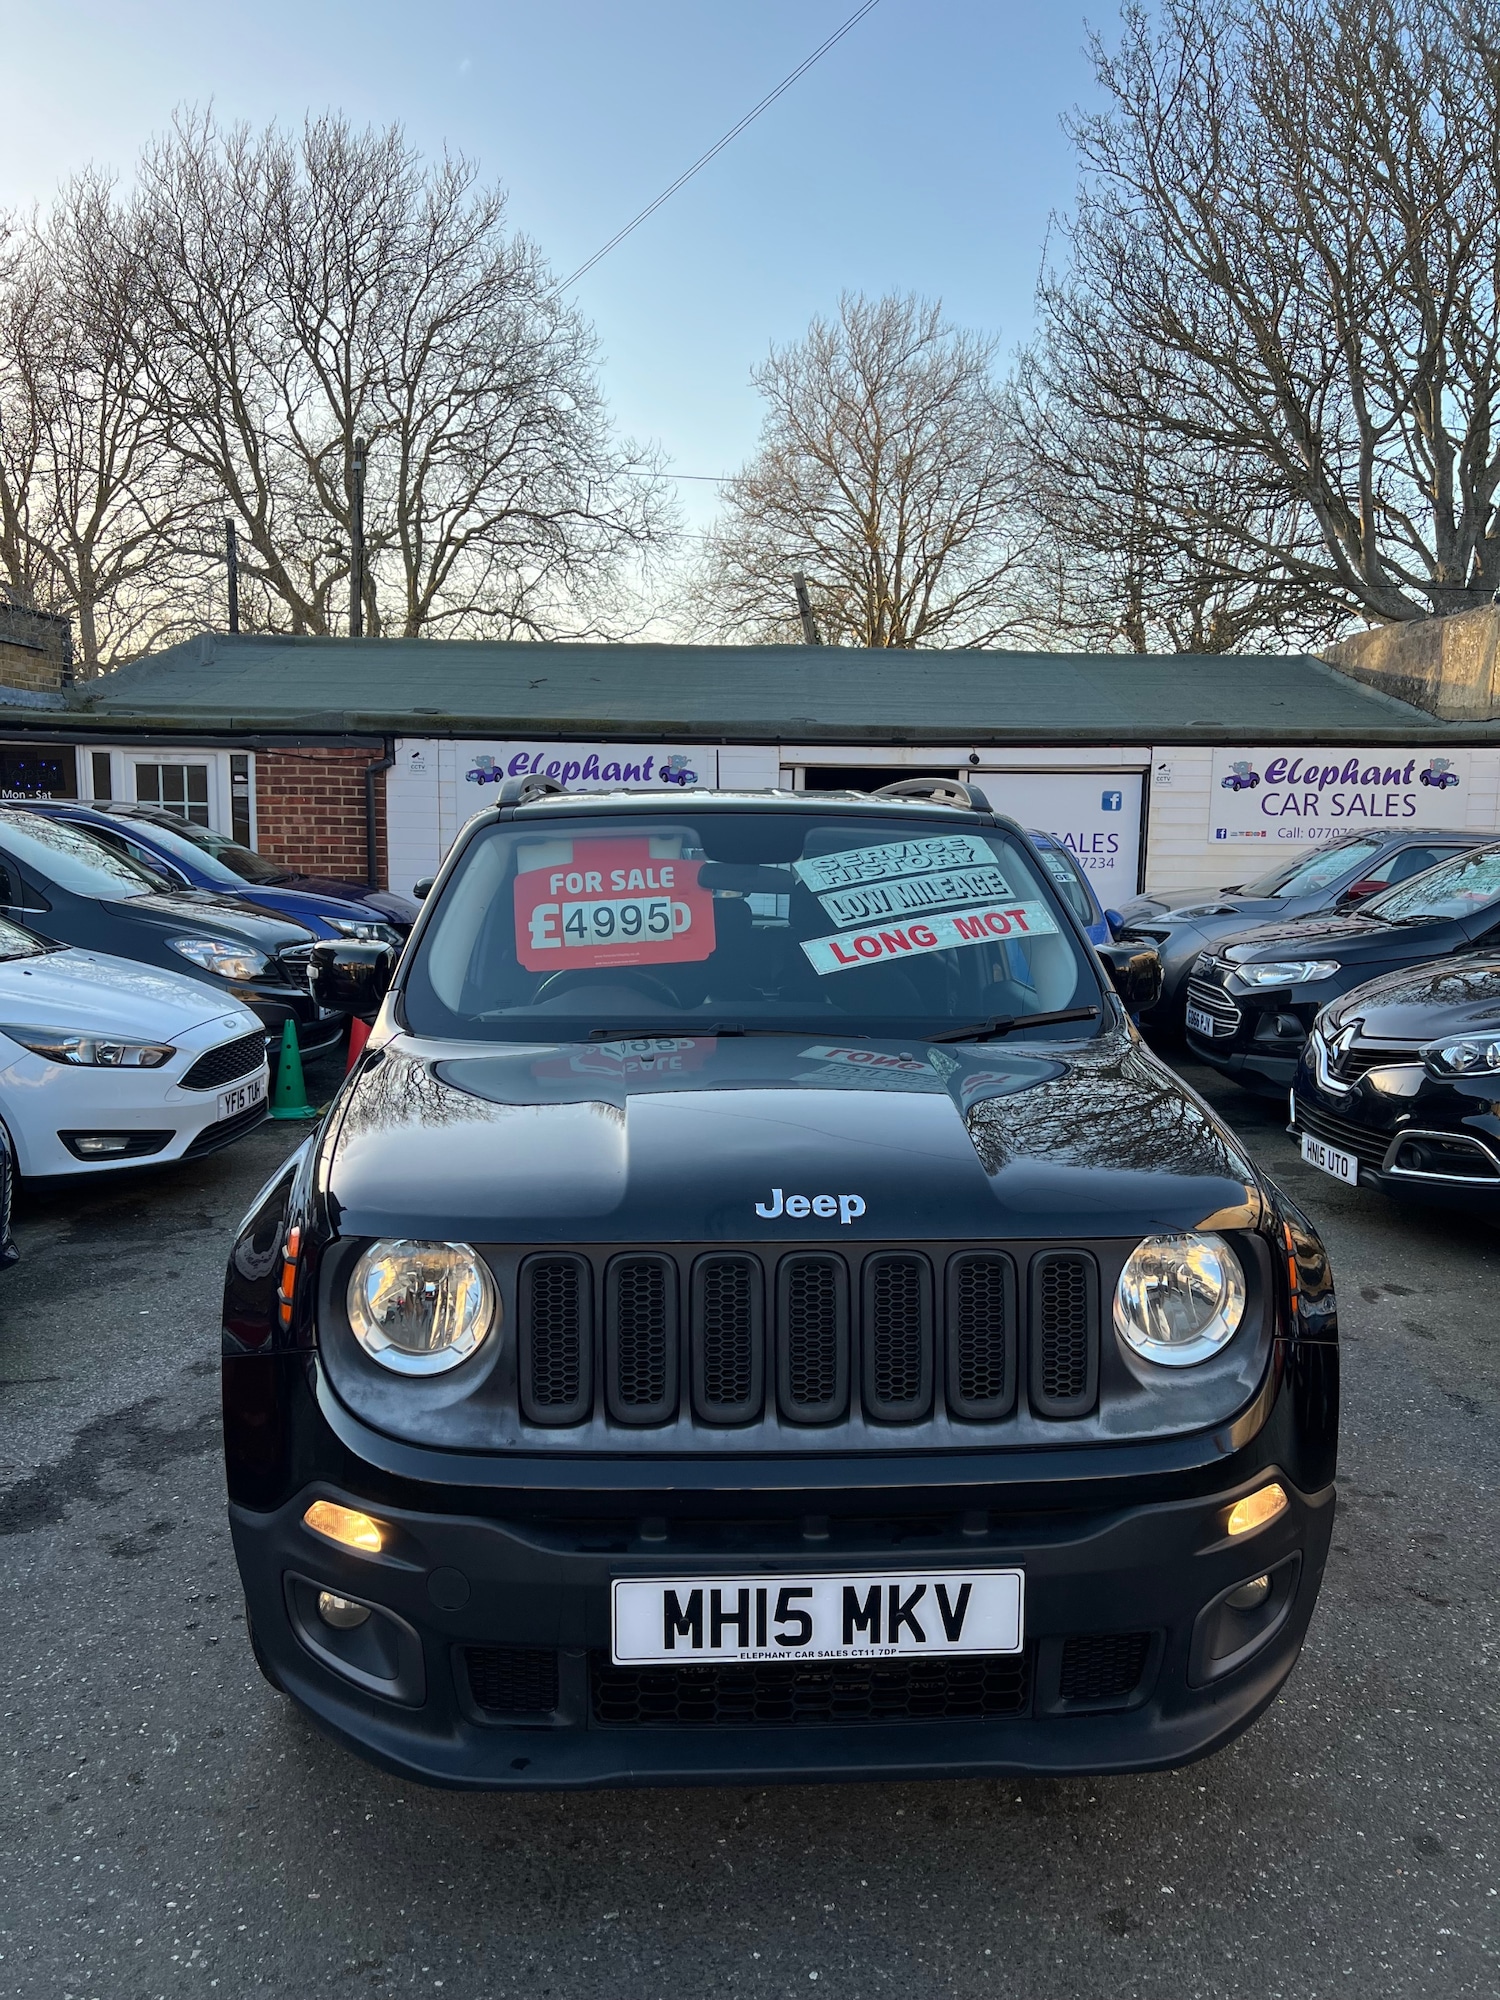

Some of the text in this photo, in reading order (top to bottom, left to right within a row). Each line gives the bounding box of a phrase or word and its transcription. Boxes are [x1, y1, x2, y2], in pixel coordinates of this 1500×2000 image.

[508, 752, 654, 787] Elephant
[1264, 757, 1417, 792] Elephant
[2, 789, 26, 799] Mon
[35, 789, 52, 800] Sat
[1261, 792, 1417, 818] CAR SALES
[1050, 832, 1119, 853] ALES
[1277, 827, 1304, 839] Call:
[812, 838, 974, 873] SERVICE
[818, 849, 975, 885] HISTORY
[550, 866, 675, 895] FOR SALE
[826, 870, 1009, 922] LOW MILEAGE
[829, 909, 1030, 965] LONG MOT
[225, 1088, 245, 1114] YF15
[1306, 1139, 1348, 1177] HN15 UTO
[755, 1188, 867, 1225] Jeep
[663, 1583, 973, 1650] MH15 MKV
[740, 1647, 897, 1660] ELEPHANT CAR SALES CT11 7DP
